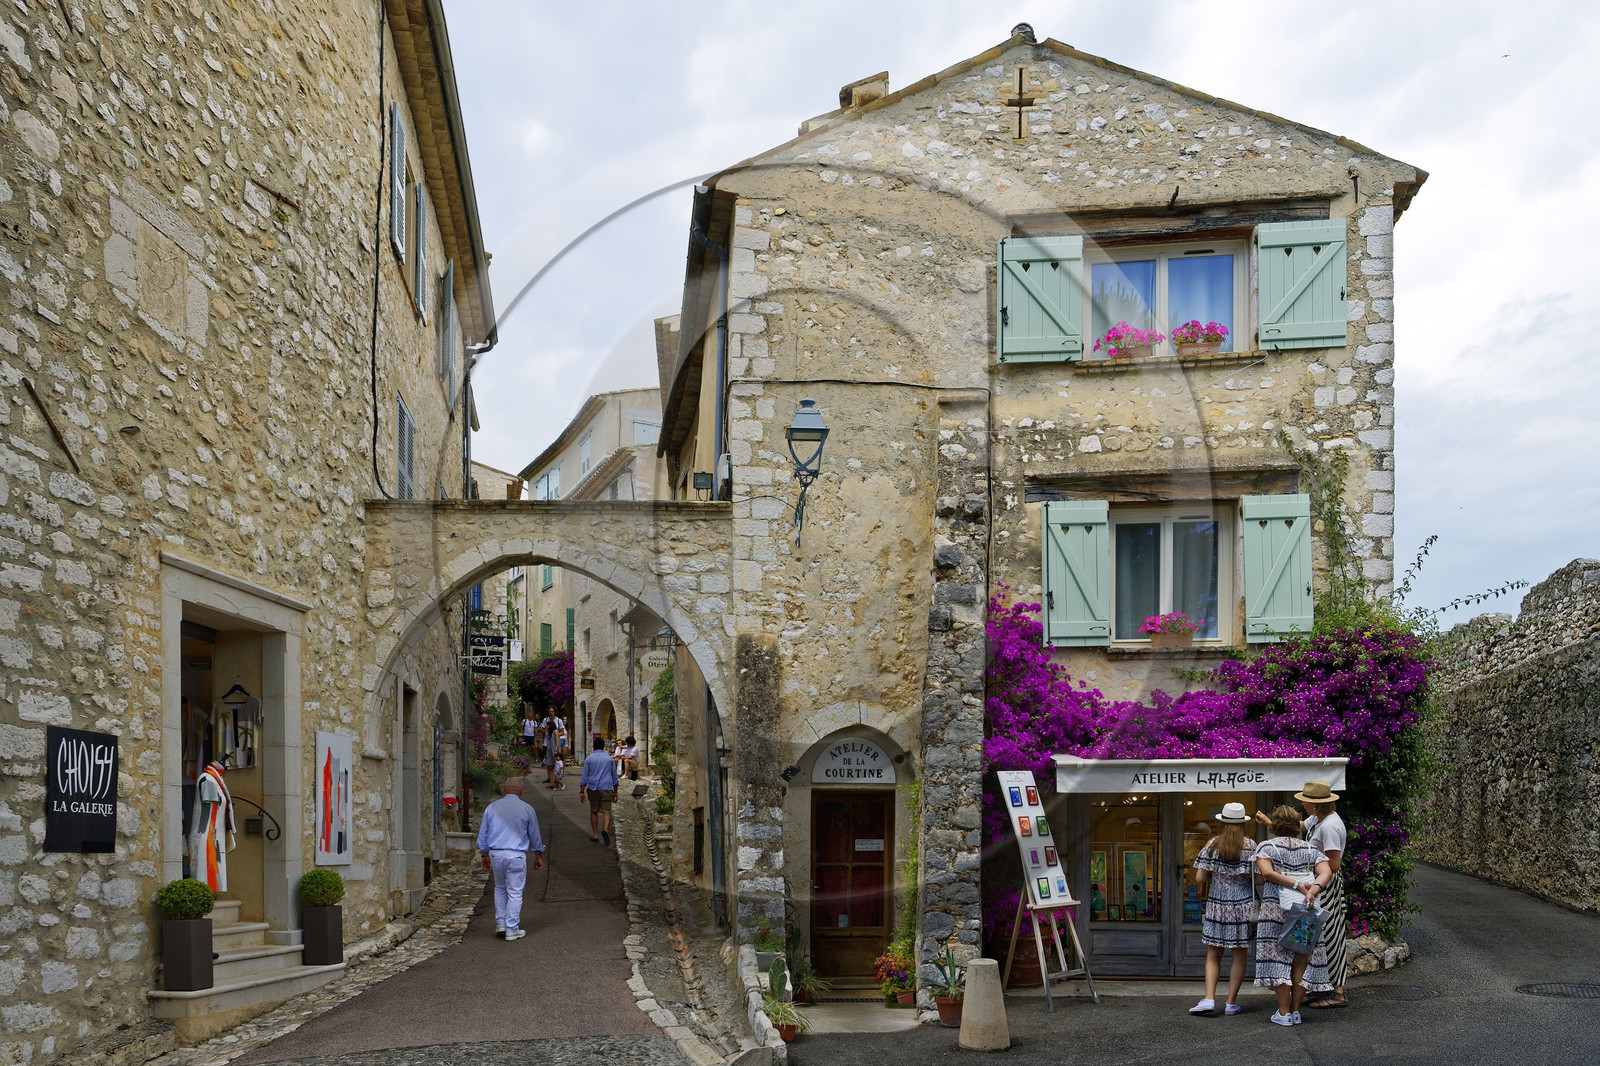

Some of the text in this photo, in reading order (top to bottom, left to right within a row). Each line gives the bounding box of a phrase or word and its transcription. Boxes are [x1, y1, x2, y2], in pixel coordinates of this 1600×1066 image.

[829, 743, 879, 762] ATELIER
[57, 737, 114, 799] CHOISY
[825, 768, 883, 778] COURTINE
[1131, 772, 1186, 784] ATELIER
[53, 800, 113, 817] LA GALERIE
